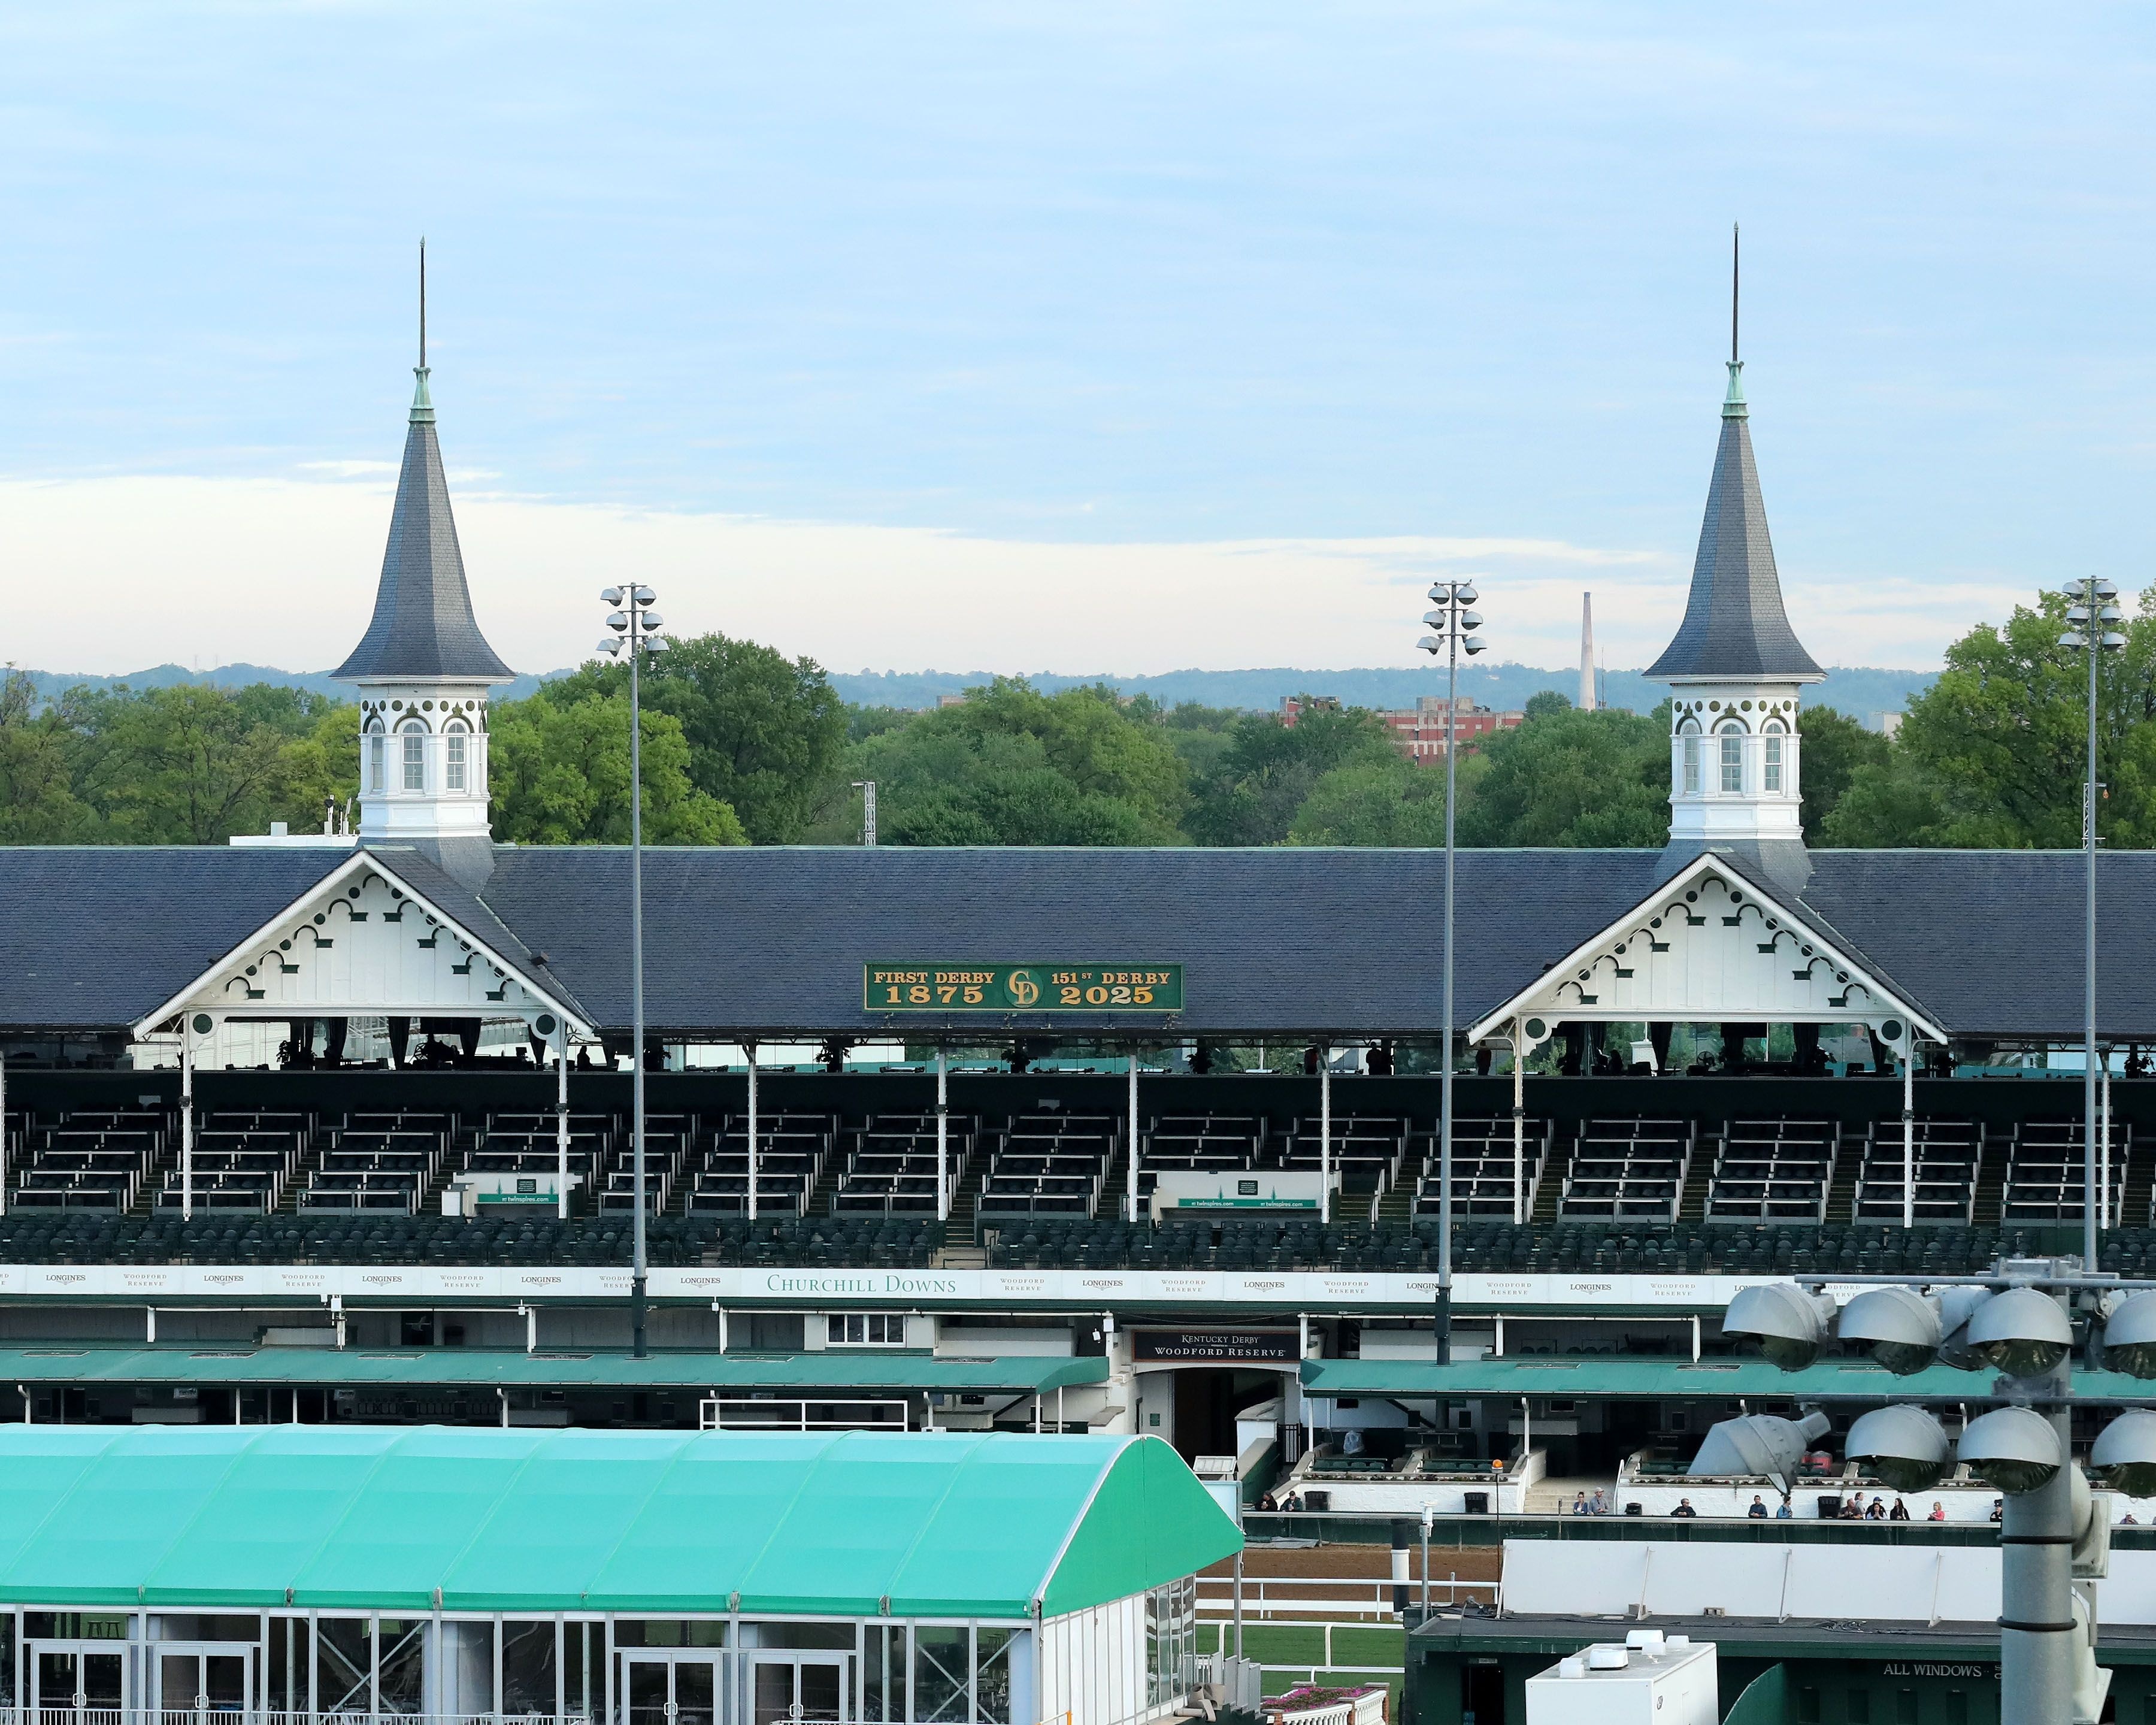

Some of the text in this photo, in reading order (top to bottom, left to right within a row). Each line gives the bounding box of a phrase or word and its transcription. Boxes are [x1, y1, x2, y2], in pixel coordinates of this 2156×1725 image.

[874, 972, 995, 983] FIRST DERBY
[1101, 972, 1170, 984] DERBY
[886, 985, 984, 1004] 1875
[1059, 986, 1153, 1004] 2025
[767, 1275, 956, 1293] CHURCHILL DOWNS
[1182, 1335, 1228, 1343] KENTUCKY
[1155, 1347, 1286, 1356] WOODFORD RESERVE
[1884, 1664, 1910, 1675] ALL
[1913, 1665, 1982, 1676] WINDOWS
